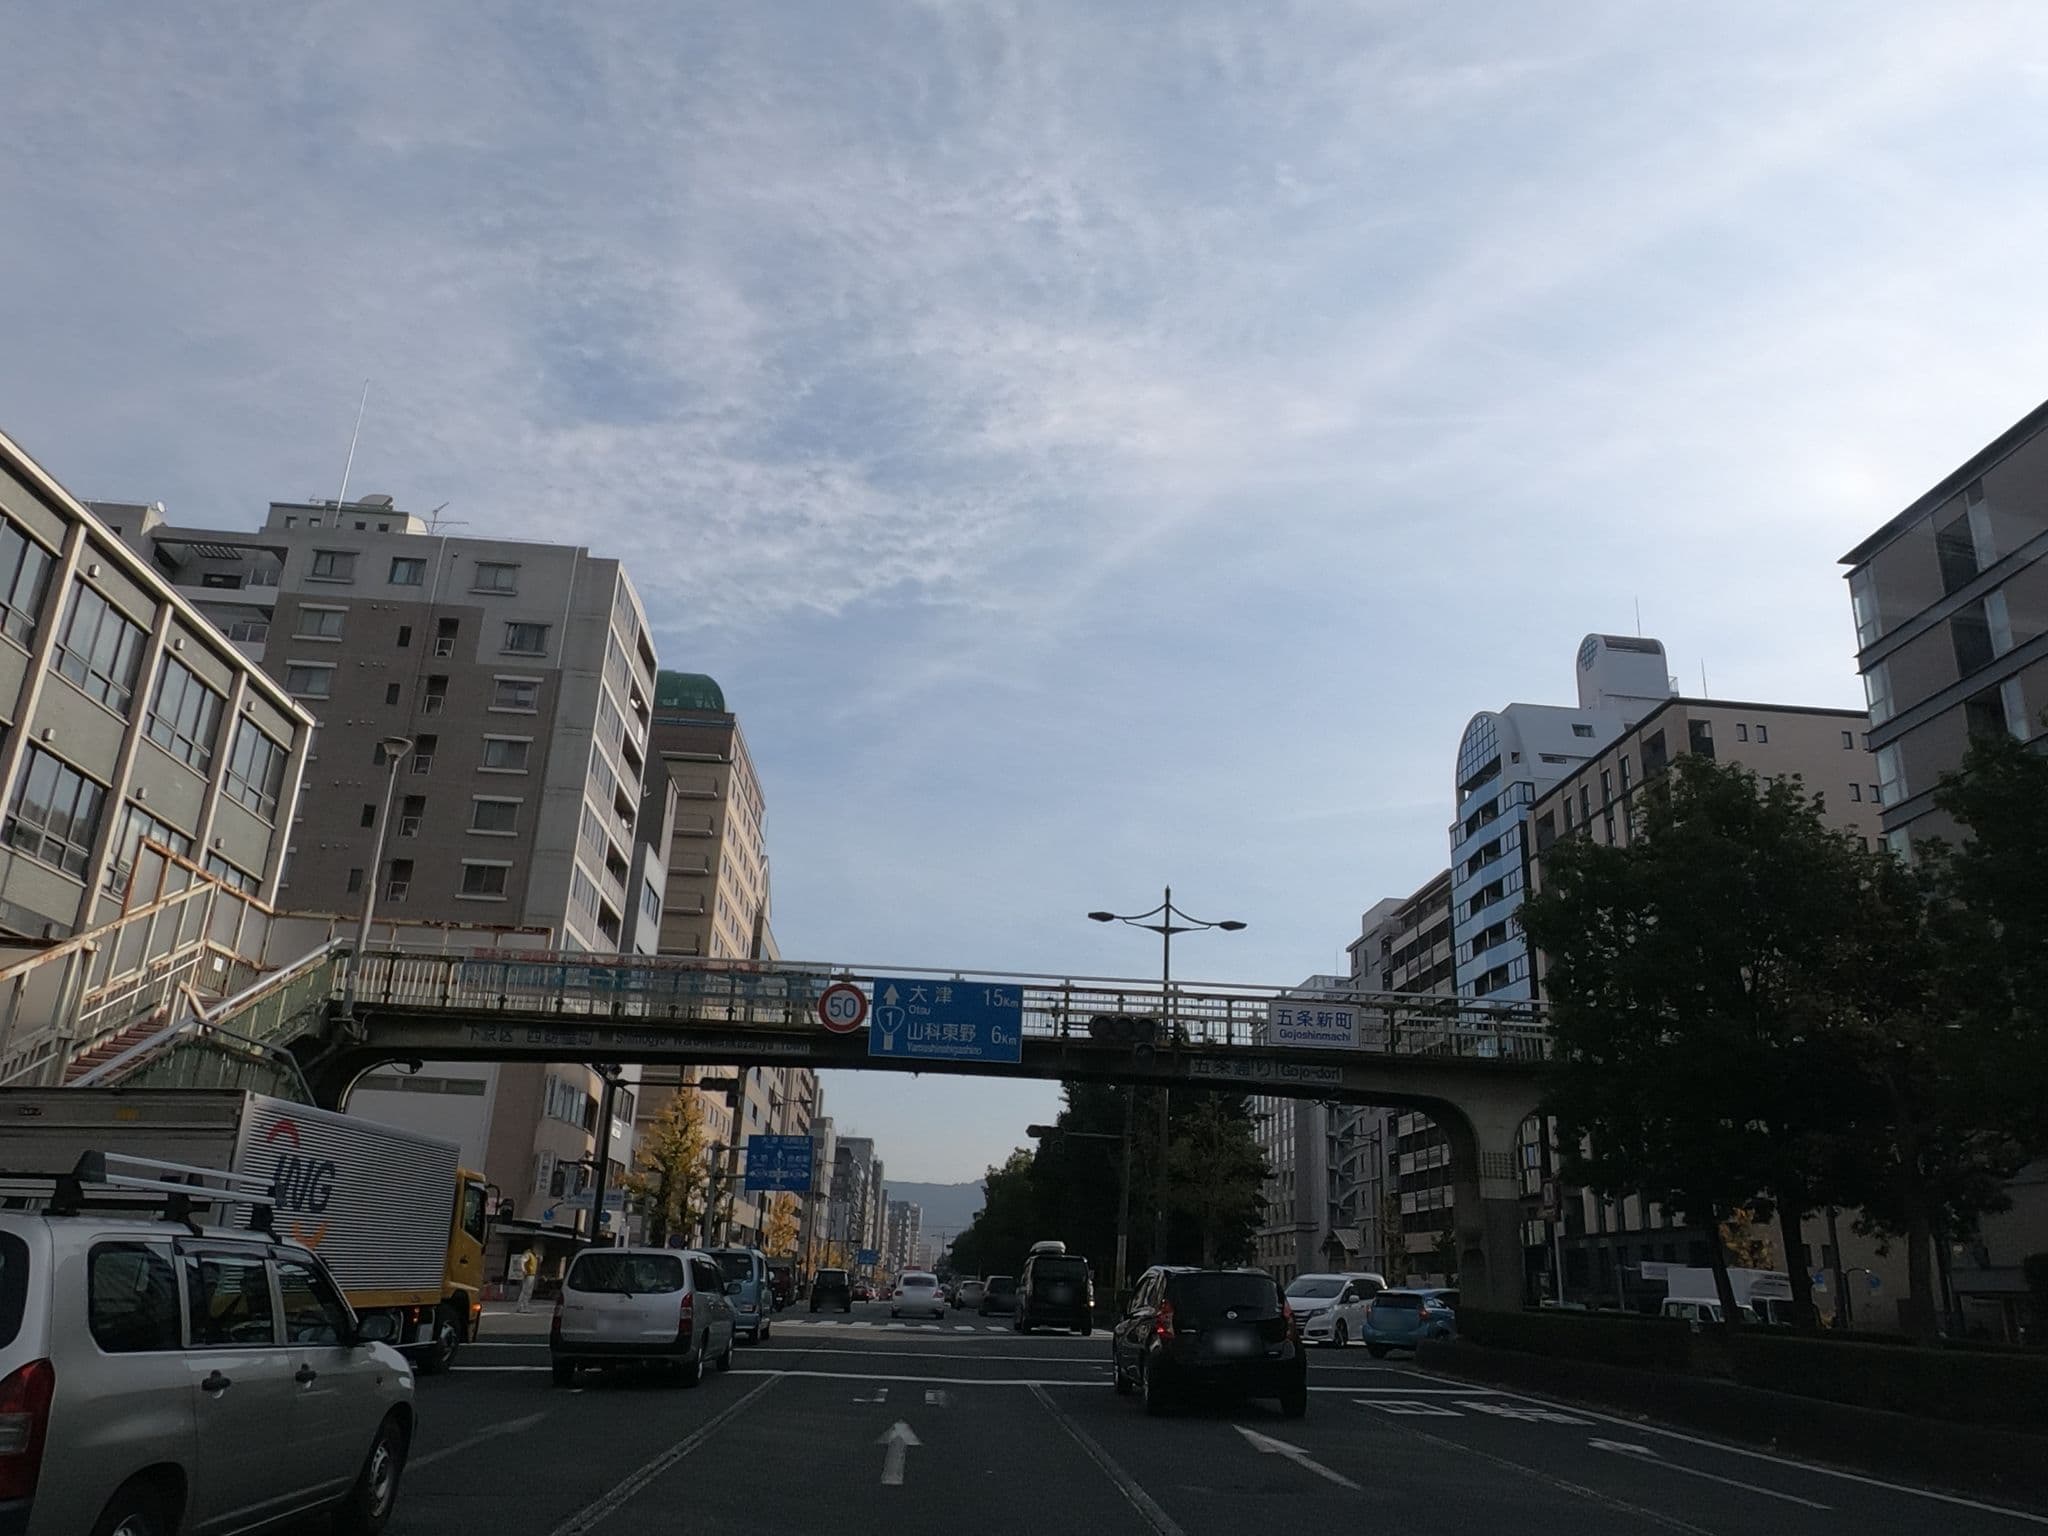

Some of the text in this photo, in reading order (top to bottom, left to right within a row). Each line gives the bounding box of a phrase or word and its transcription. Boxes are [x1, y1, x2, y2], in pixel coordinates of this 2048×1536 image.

[909, 985, 953, 1004] 大津
[830, 996, 856, 1018] 50
[908, 1005, 931, 1015] Otsu
[886, 1011, 893, 1026] 1
[1277, 1009, 1353, 1030] 五条新町
[907, 1022, 976, 1042] 山科東野
[1279, 1029, 1351, 1041] Gojoshinmachi
[1281, 1063, 1340, 1080] Gojo-dori
